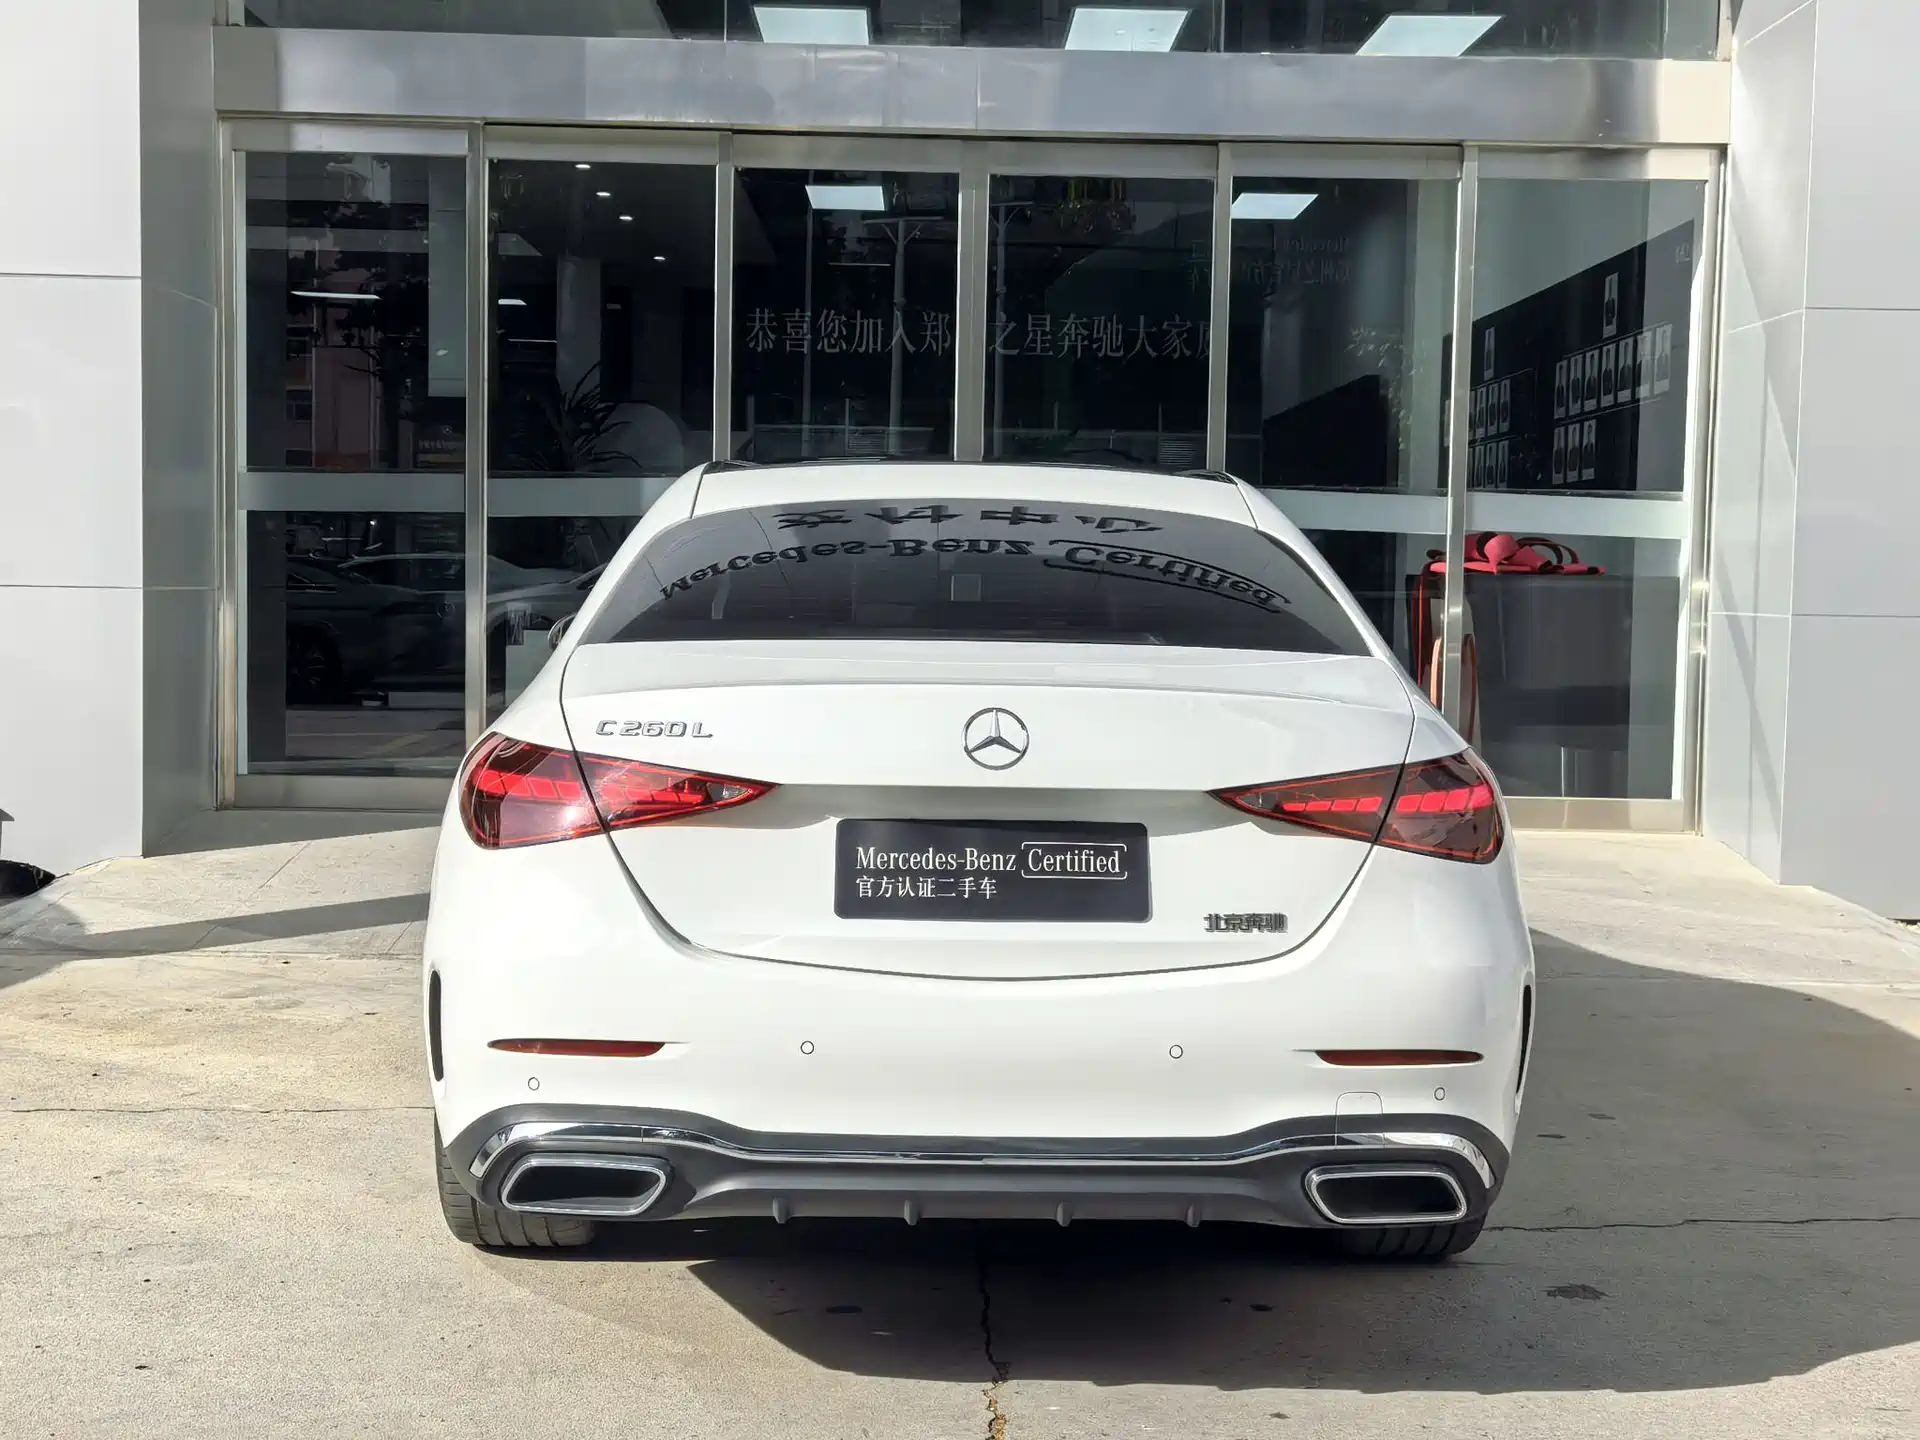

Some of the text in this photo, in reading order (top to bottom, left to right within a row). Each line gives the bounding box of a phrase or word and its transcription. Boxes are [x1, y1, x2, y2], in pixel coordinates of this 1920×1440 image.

[745, 307, 1210, 360] 恭喜您加入郑之星奔驰大家
[855, 846, 1121, 874] Mercedes-Benz Certified
[855, 876, 997, 900] 官方认证二手车
[1203, 913, 1288, 934] 北京奔驰
